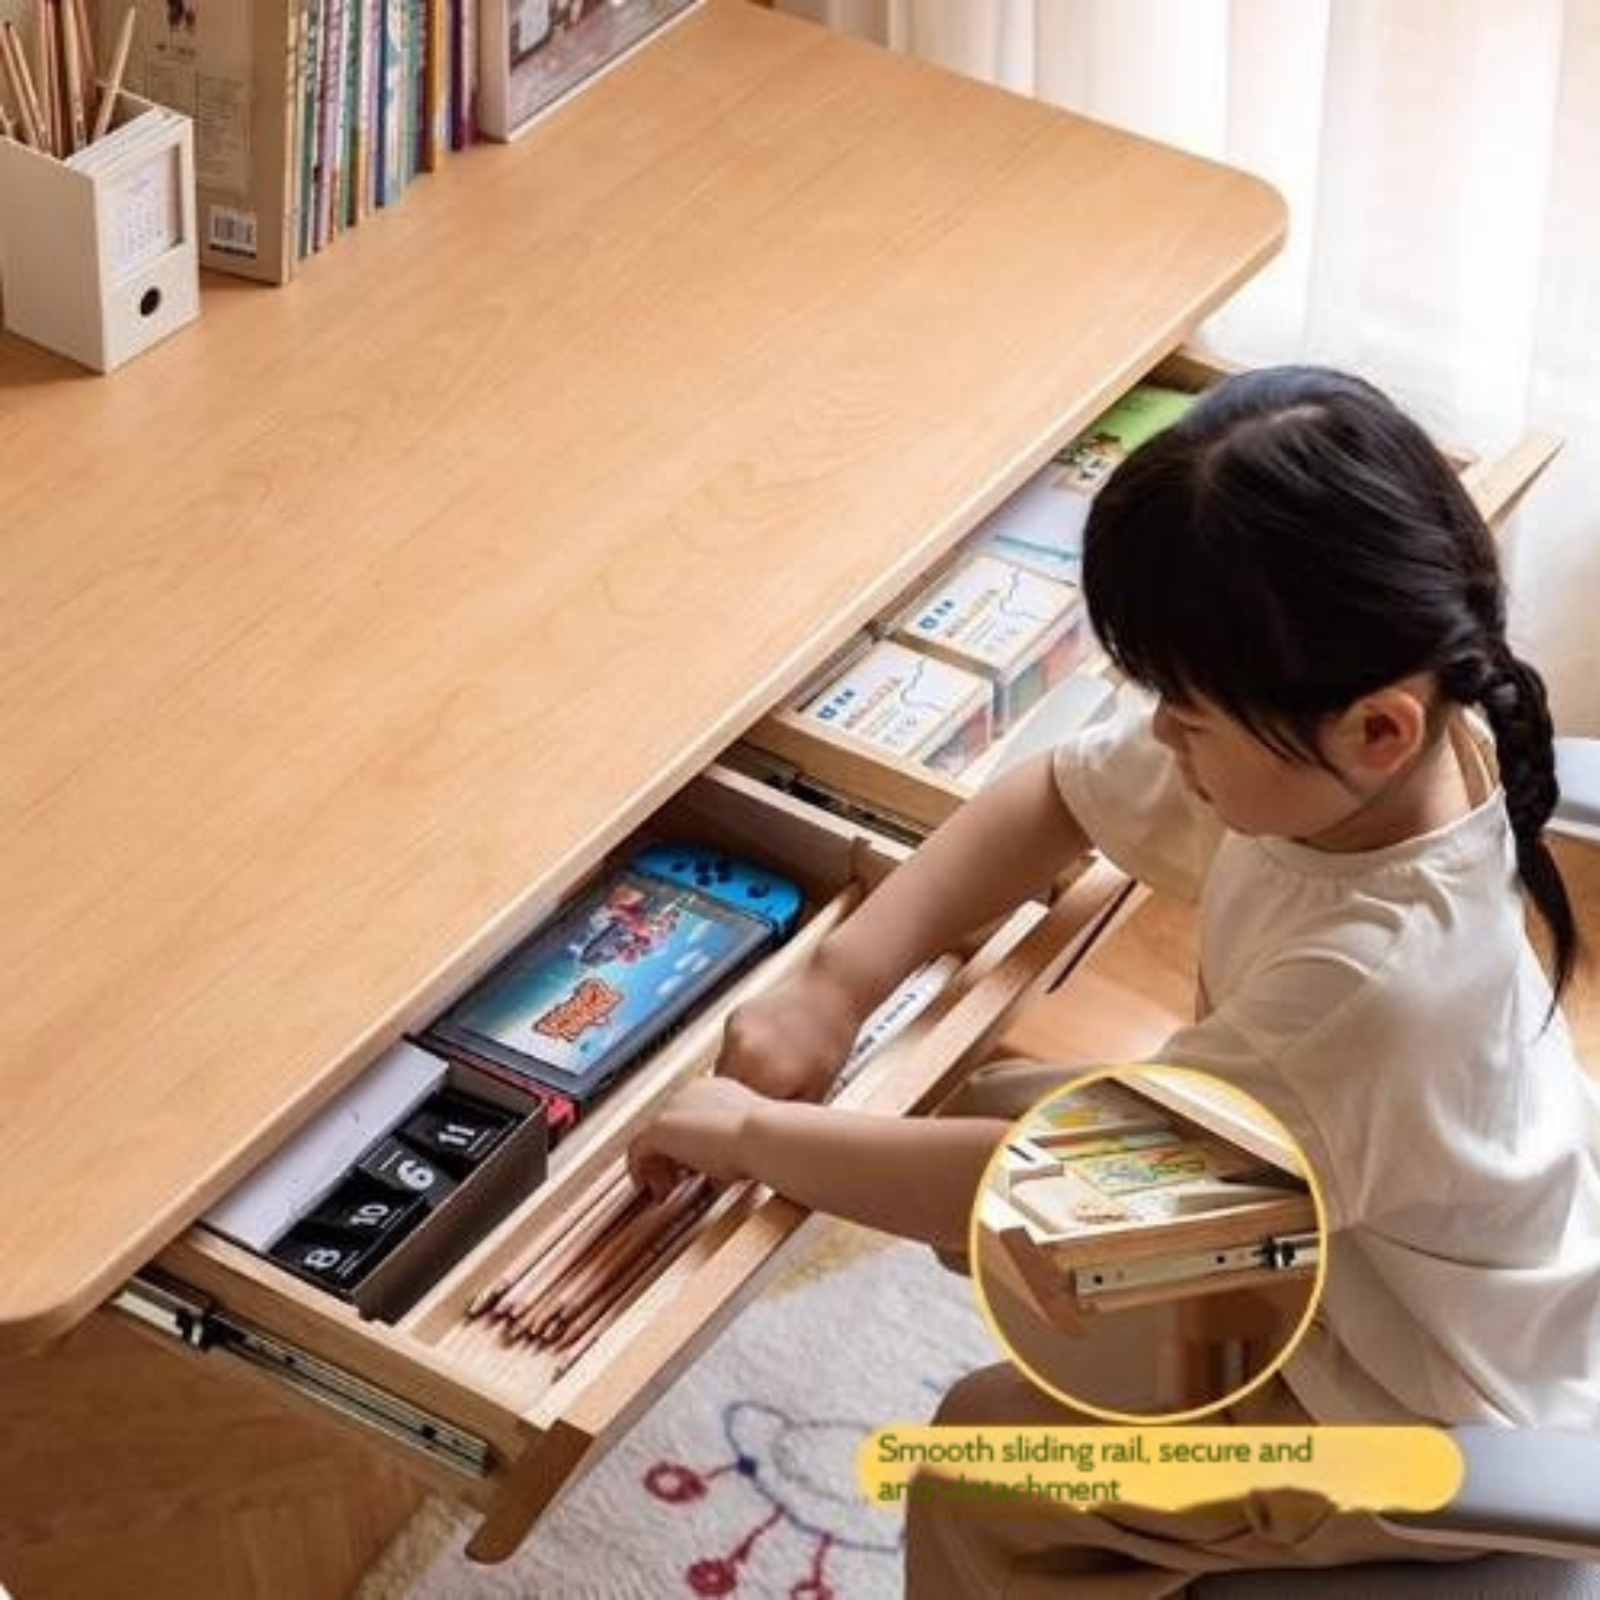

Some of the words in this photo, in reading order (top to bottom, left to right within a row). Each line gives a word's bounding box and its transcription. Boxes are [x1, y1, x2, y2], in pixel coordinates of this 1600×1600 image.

[438, 1124, 476, 1146] 11
[350, 1203, 390, 1226] 10
[304, 1248, 342, 1270] 8
